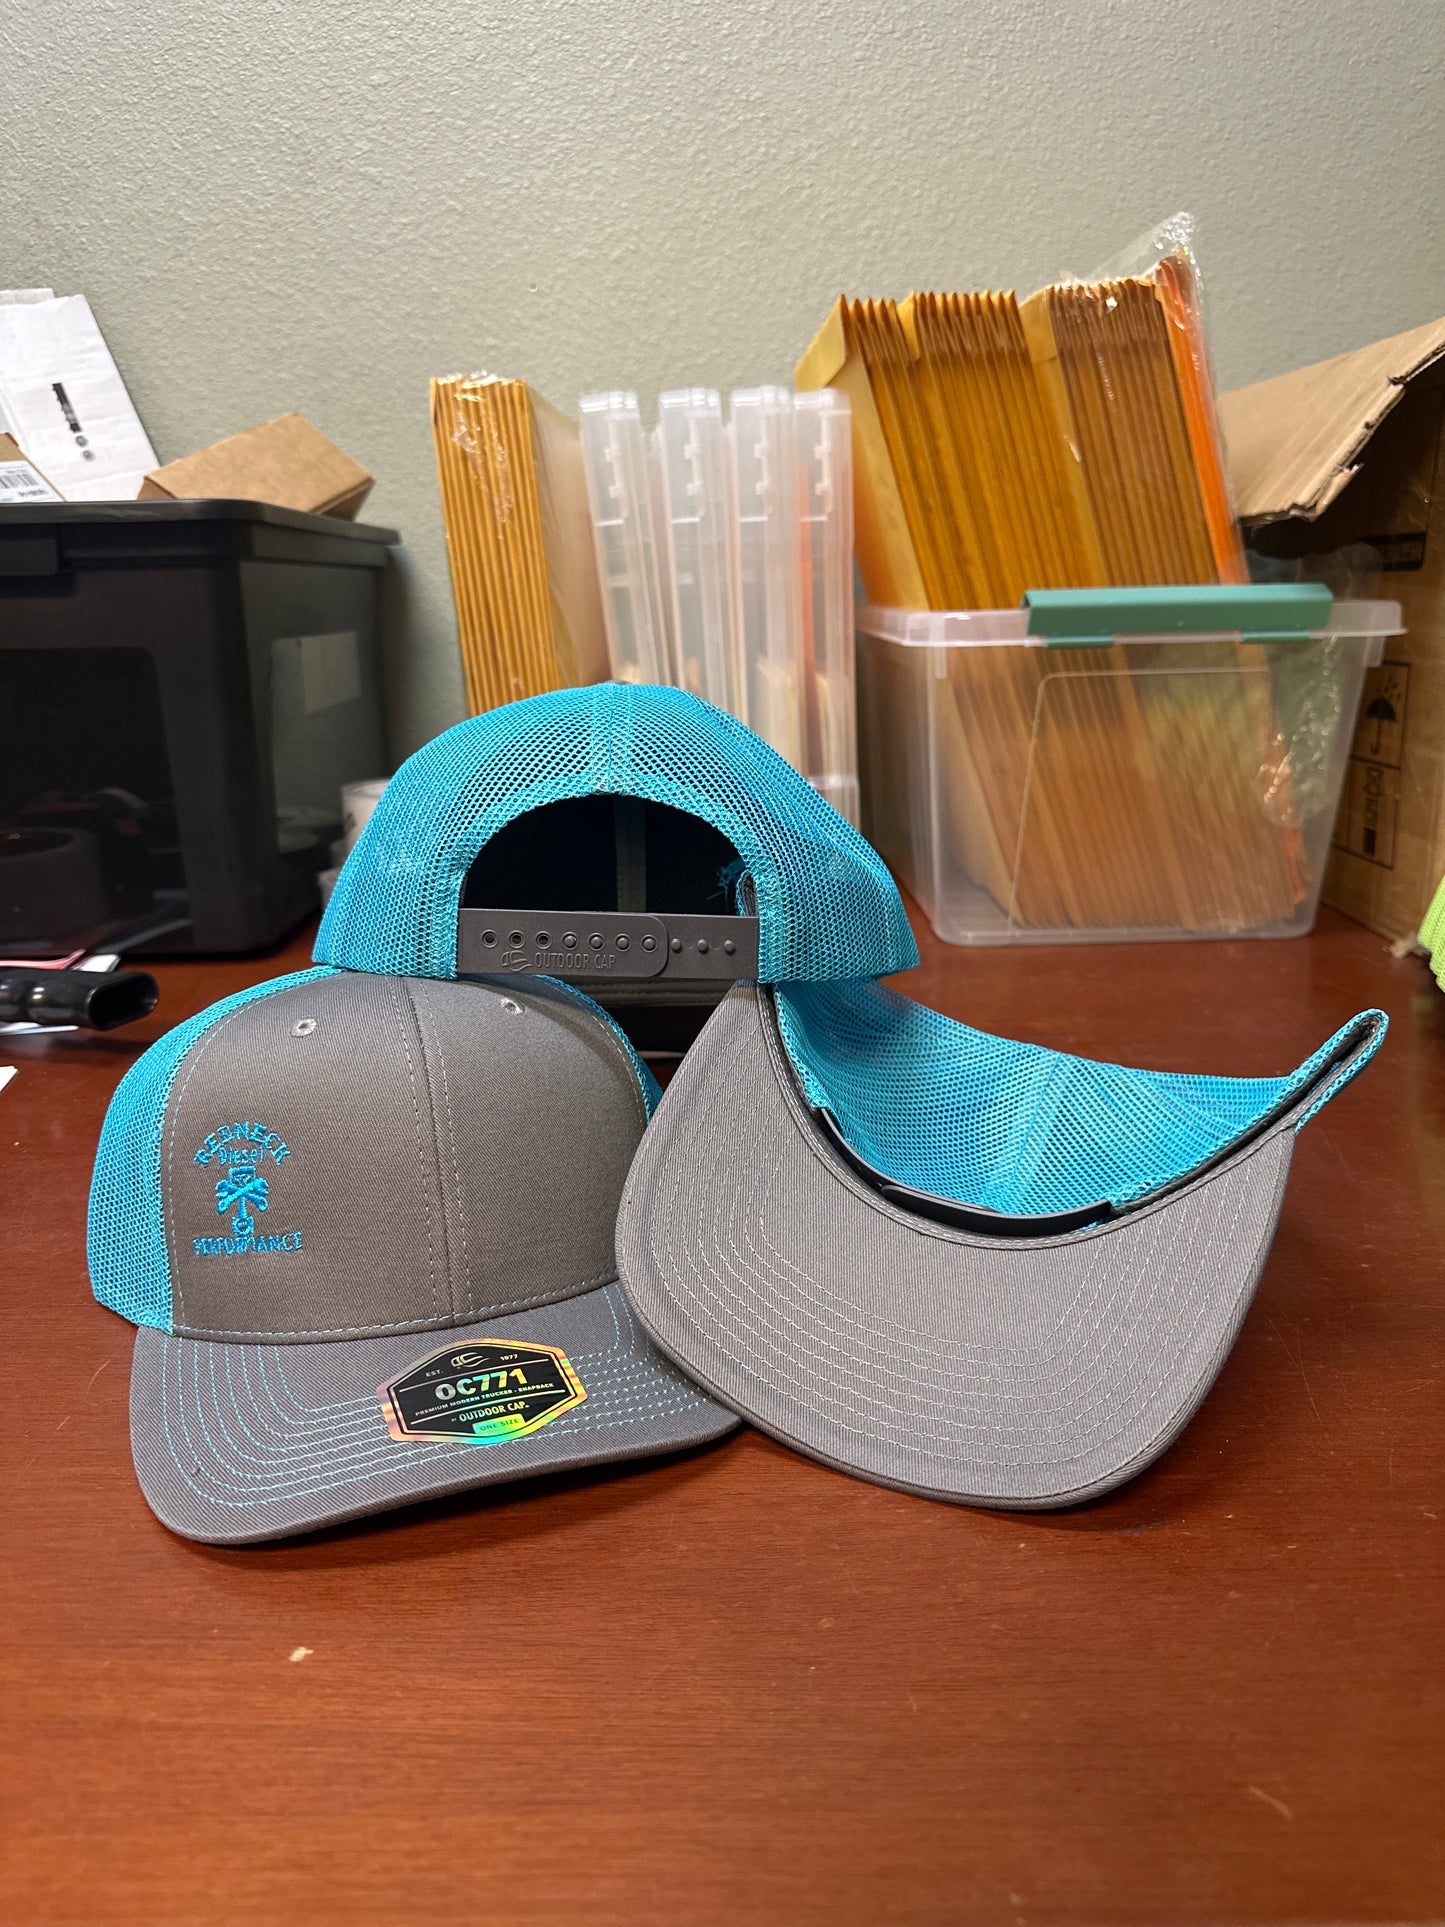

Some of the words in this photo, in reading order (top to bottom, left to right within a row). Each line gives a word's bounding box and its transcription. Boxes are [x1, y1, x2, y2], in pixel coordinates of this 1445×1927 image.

[534, 953, 591, 970] OUTDOOR
[594, 954, 616, 971] CAP
[193, 1121, 292, 1167] REDNECK
[218, 1146, 264, 1165] Diesel
[192, 1231, 303, 1257] PERFORMANCE
[434, 1368, 528, 1400] OC771
[415, 1404, 449, 1416] PREMIUM
[450, 1396, 480, 1407] MODERN
[481, 1389, 513, 1399] TRUCKER
[517, 1382, 555, 1392] SNAPBACK
[459, 1405, 506, 1422] OUTDOOR
[480, 1422, 498, 1431] ONE
[501, 1418, 520, 1427] SIZE
